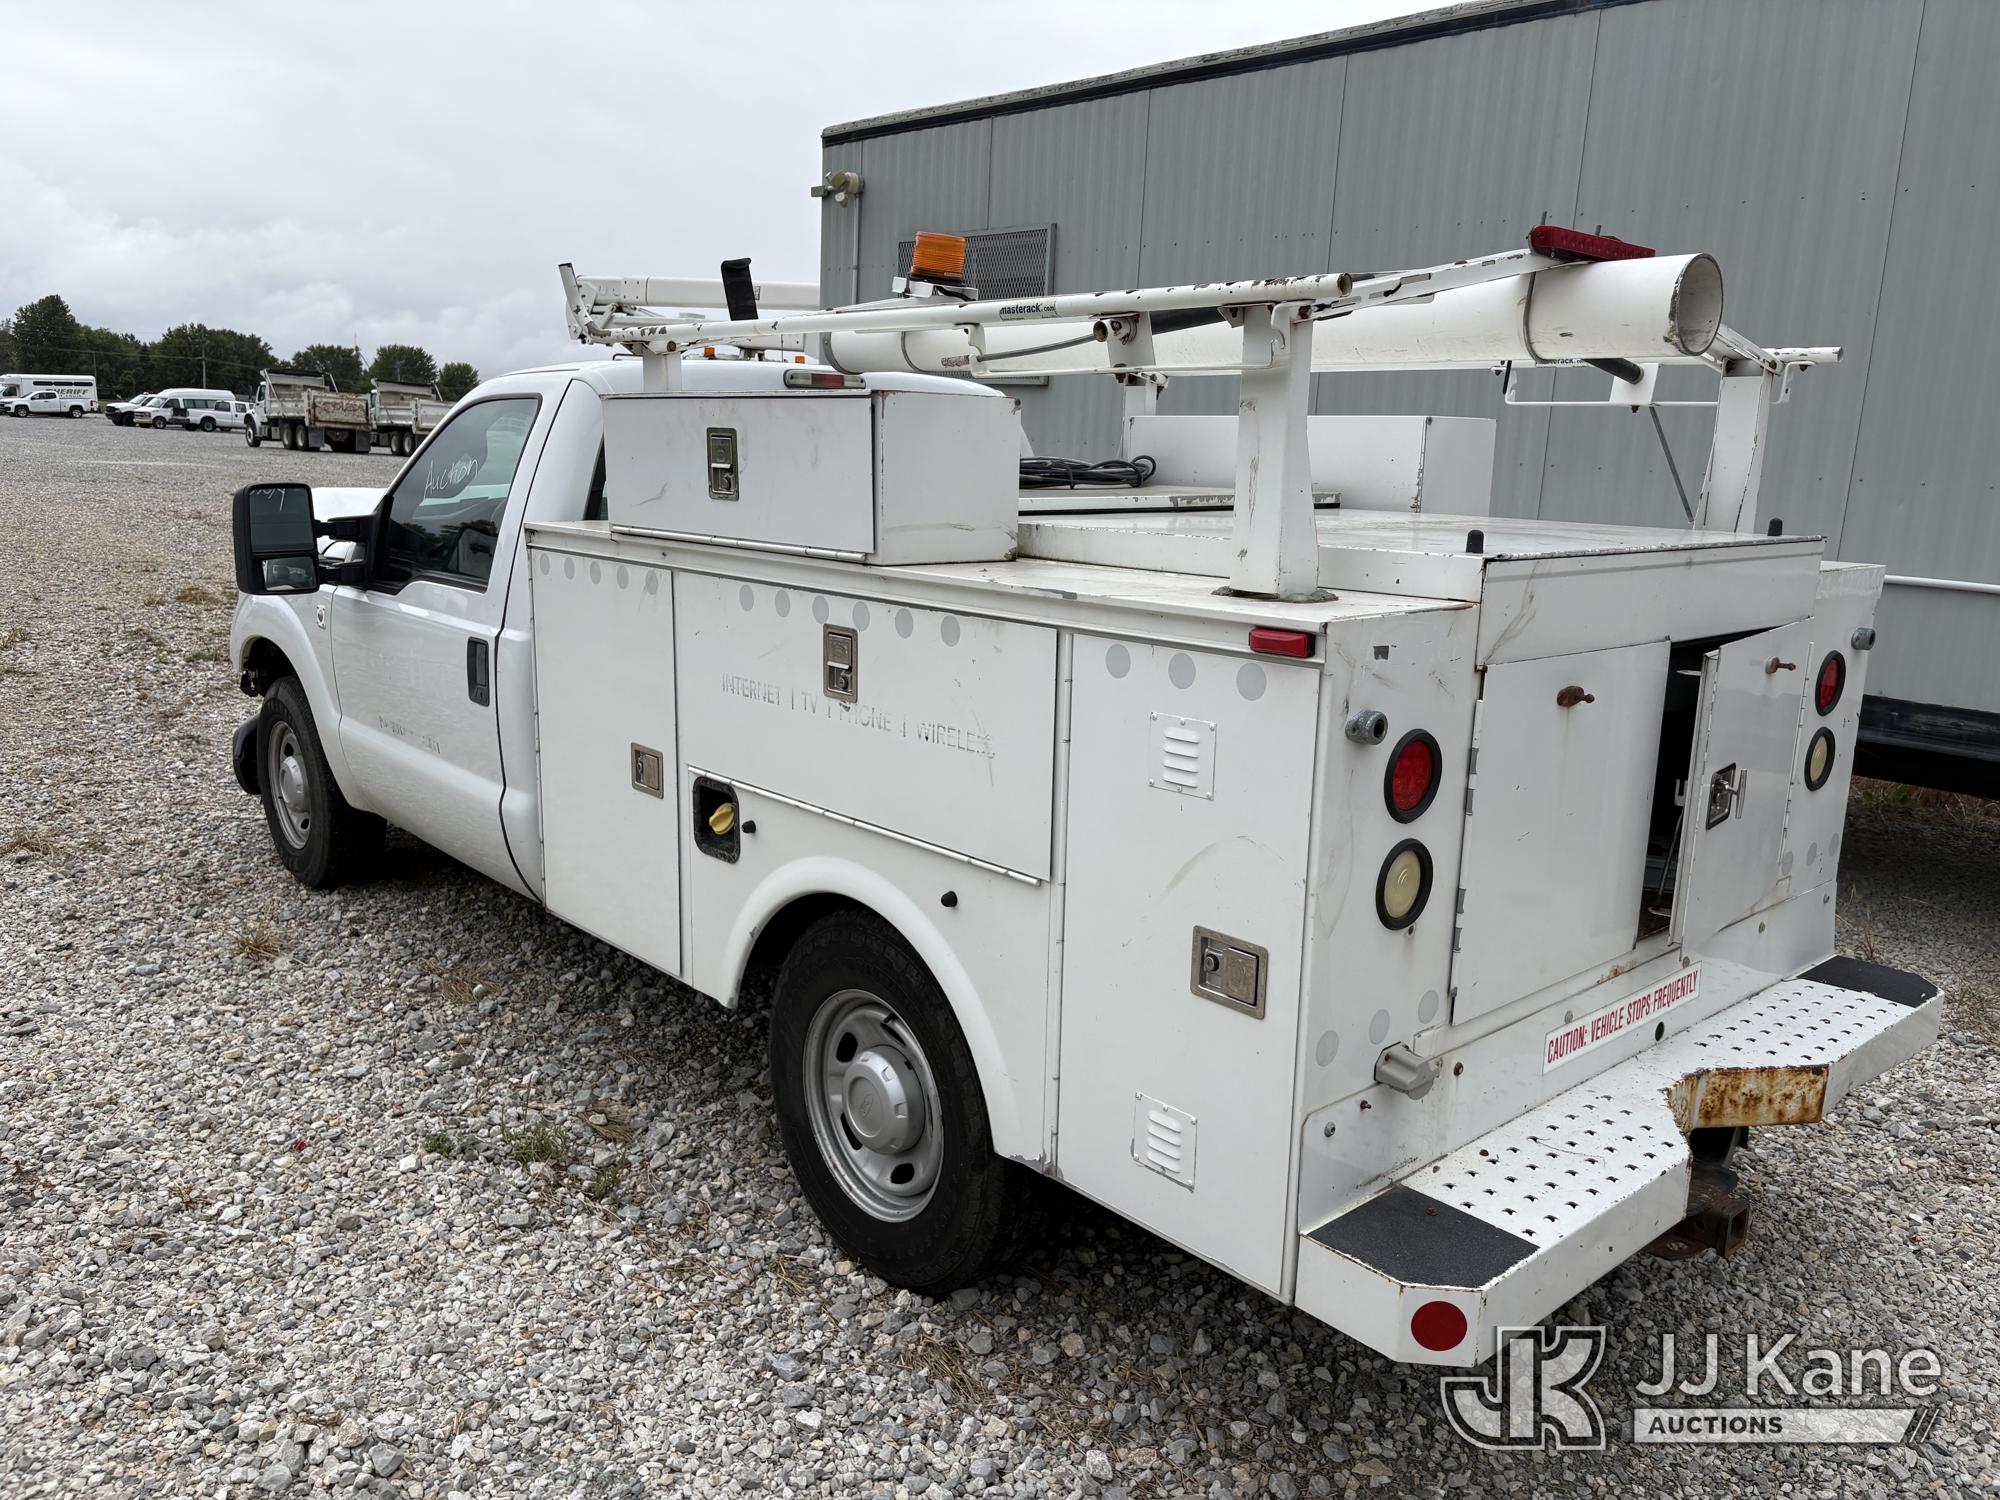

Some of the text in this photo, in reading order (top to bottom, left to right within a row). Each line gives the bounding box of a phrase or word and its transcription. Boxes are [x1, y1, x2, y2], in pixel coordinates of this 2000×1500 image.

[423, 459, 478, 499] Auction
[721, 672, 780, 706] INTERNET
[801, 690, 818, 714] TV
[1547, 970, 1698, 1064] CAUTION: VEHICLE STOPS FREQUENTLY
